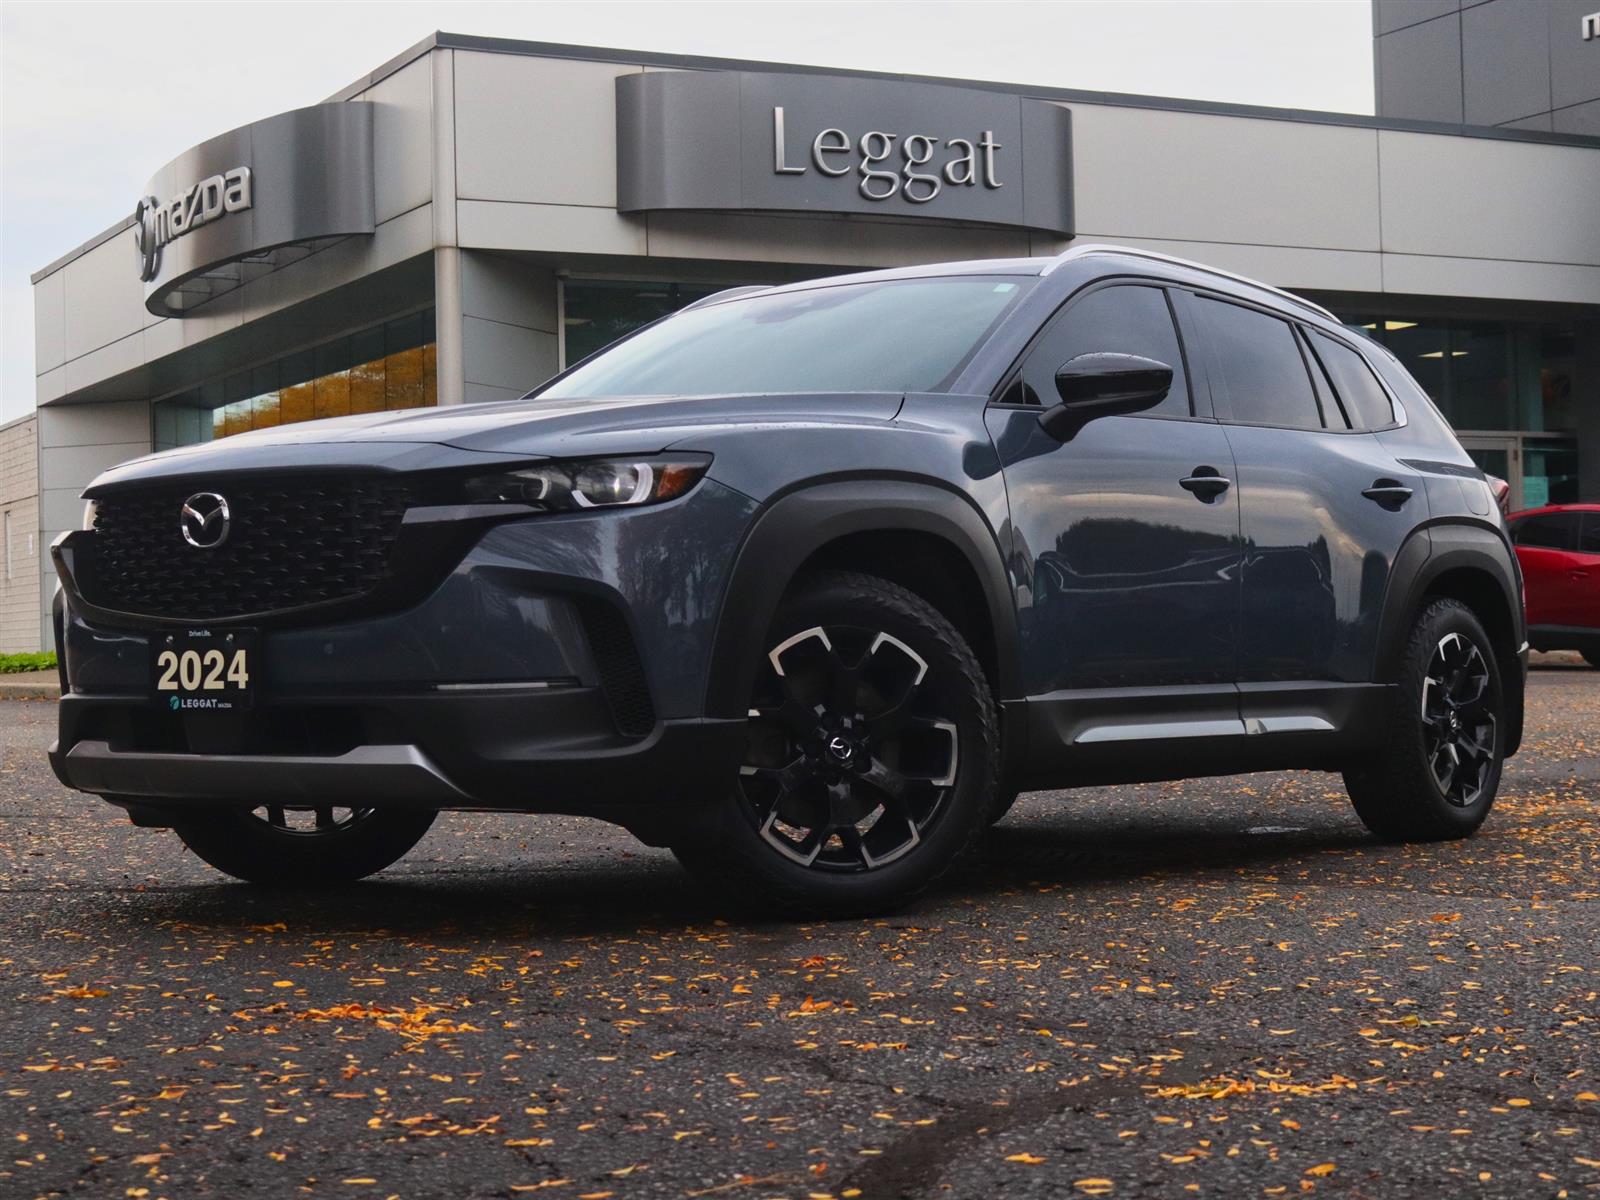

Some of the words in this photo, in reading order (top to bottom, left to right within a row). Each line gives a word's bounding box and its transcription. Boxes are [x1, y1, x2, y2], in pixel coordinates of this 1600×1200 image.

[774, 106, 1003, 203] Leggat
[157, 649, 249, 691] 2024
[181, 699, 217, 708] LEGGAT
